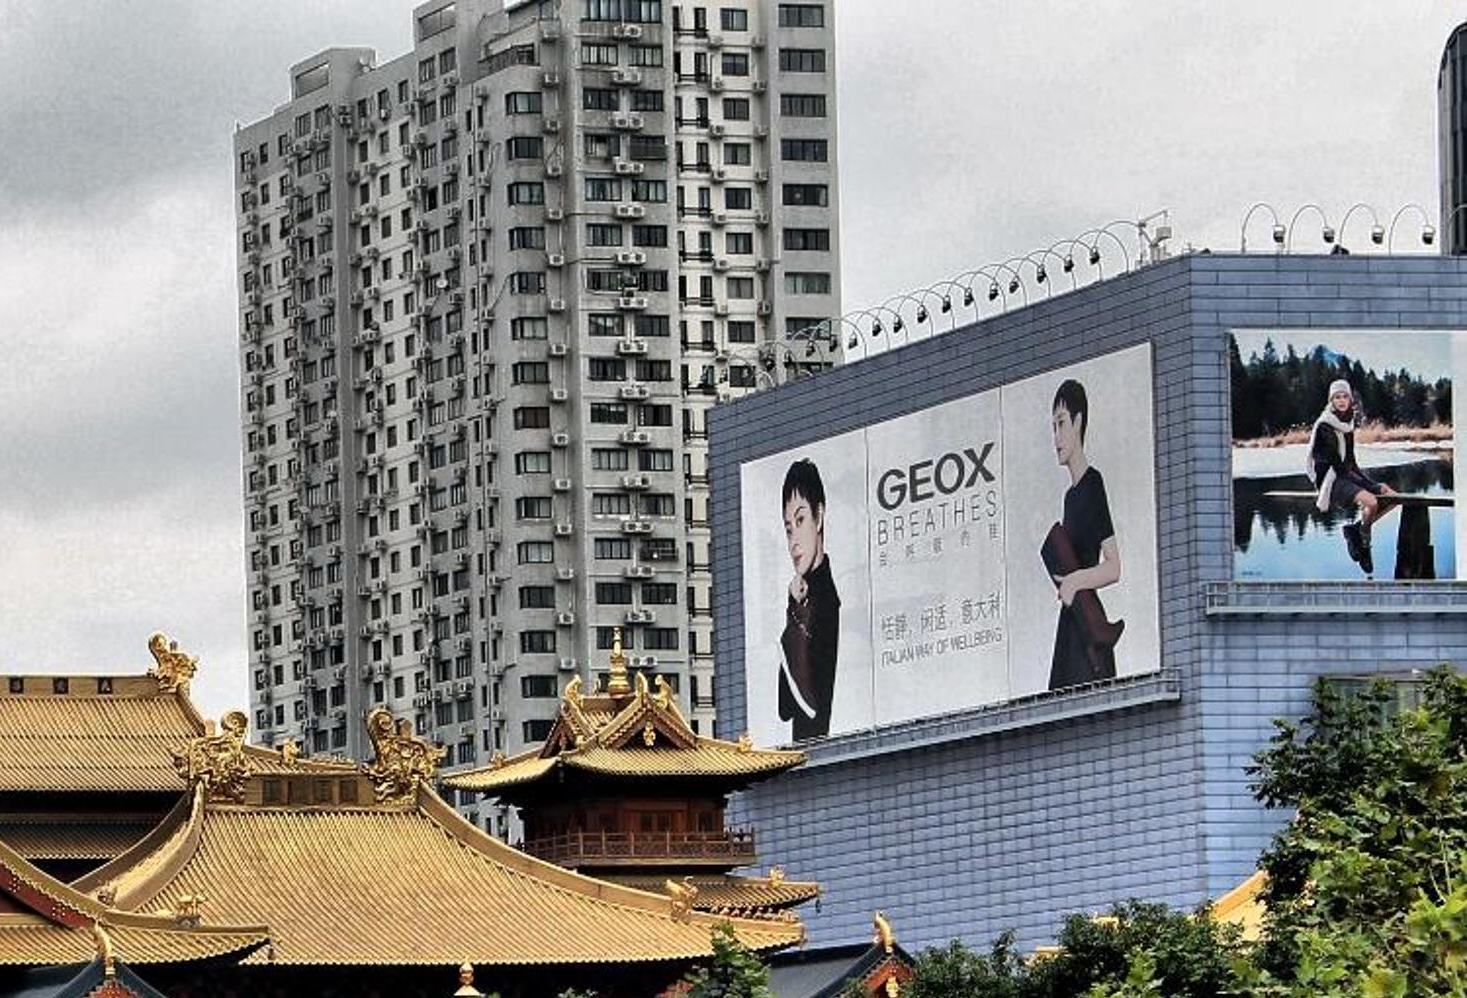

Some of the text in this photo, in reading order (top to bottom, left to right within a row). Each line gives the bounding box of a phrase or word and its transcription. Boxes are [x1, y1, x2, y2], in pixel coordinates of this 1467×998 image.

[877, 442, 995, 511] GEOX
[878, 490, 997, 545] BREATHES
[937, 637, 949, 654] OF
[950, 627, 1002, 651] WELLBEING
